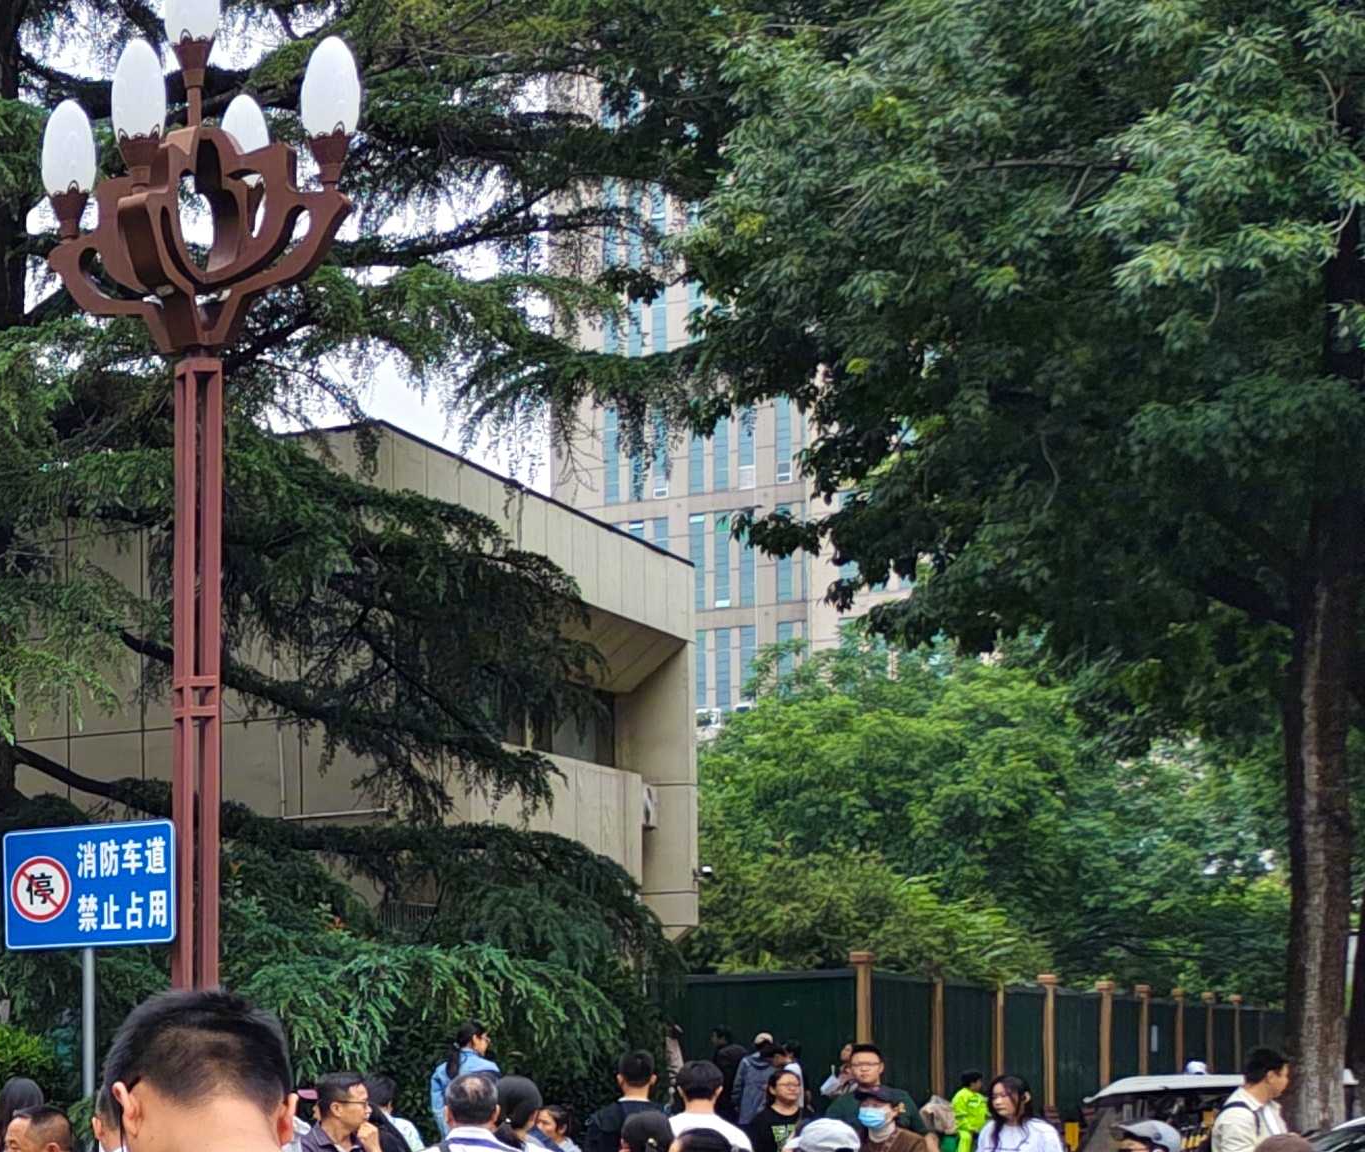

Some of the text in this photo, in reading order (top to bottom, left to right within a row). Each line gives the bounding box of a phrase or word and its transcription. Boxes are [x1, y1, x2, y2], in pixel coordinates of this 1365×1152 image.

[76, 836, 167, 879] 消防车道
[26, 872, 55, 906] 停
[77, 890, 168, 932] 禁止占用
